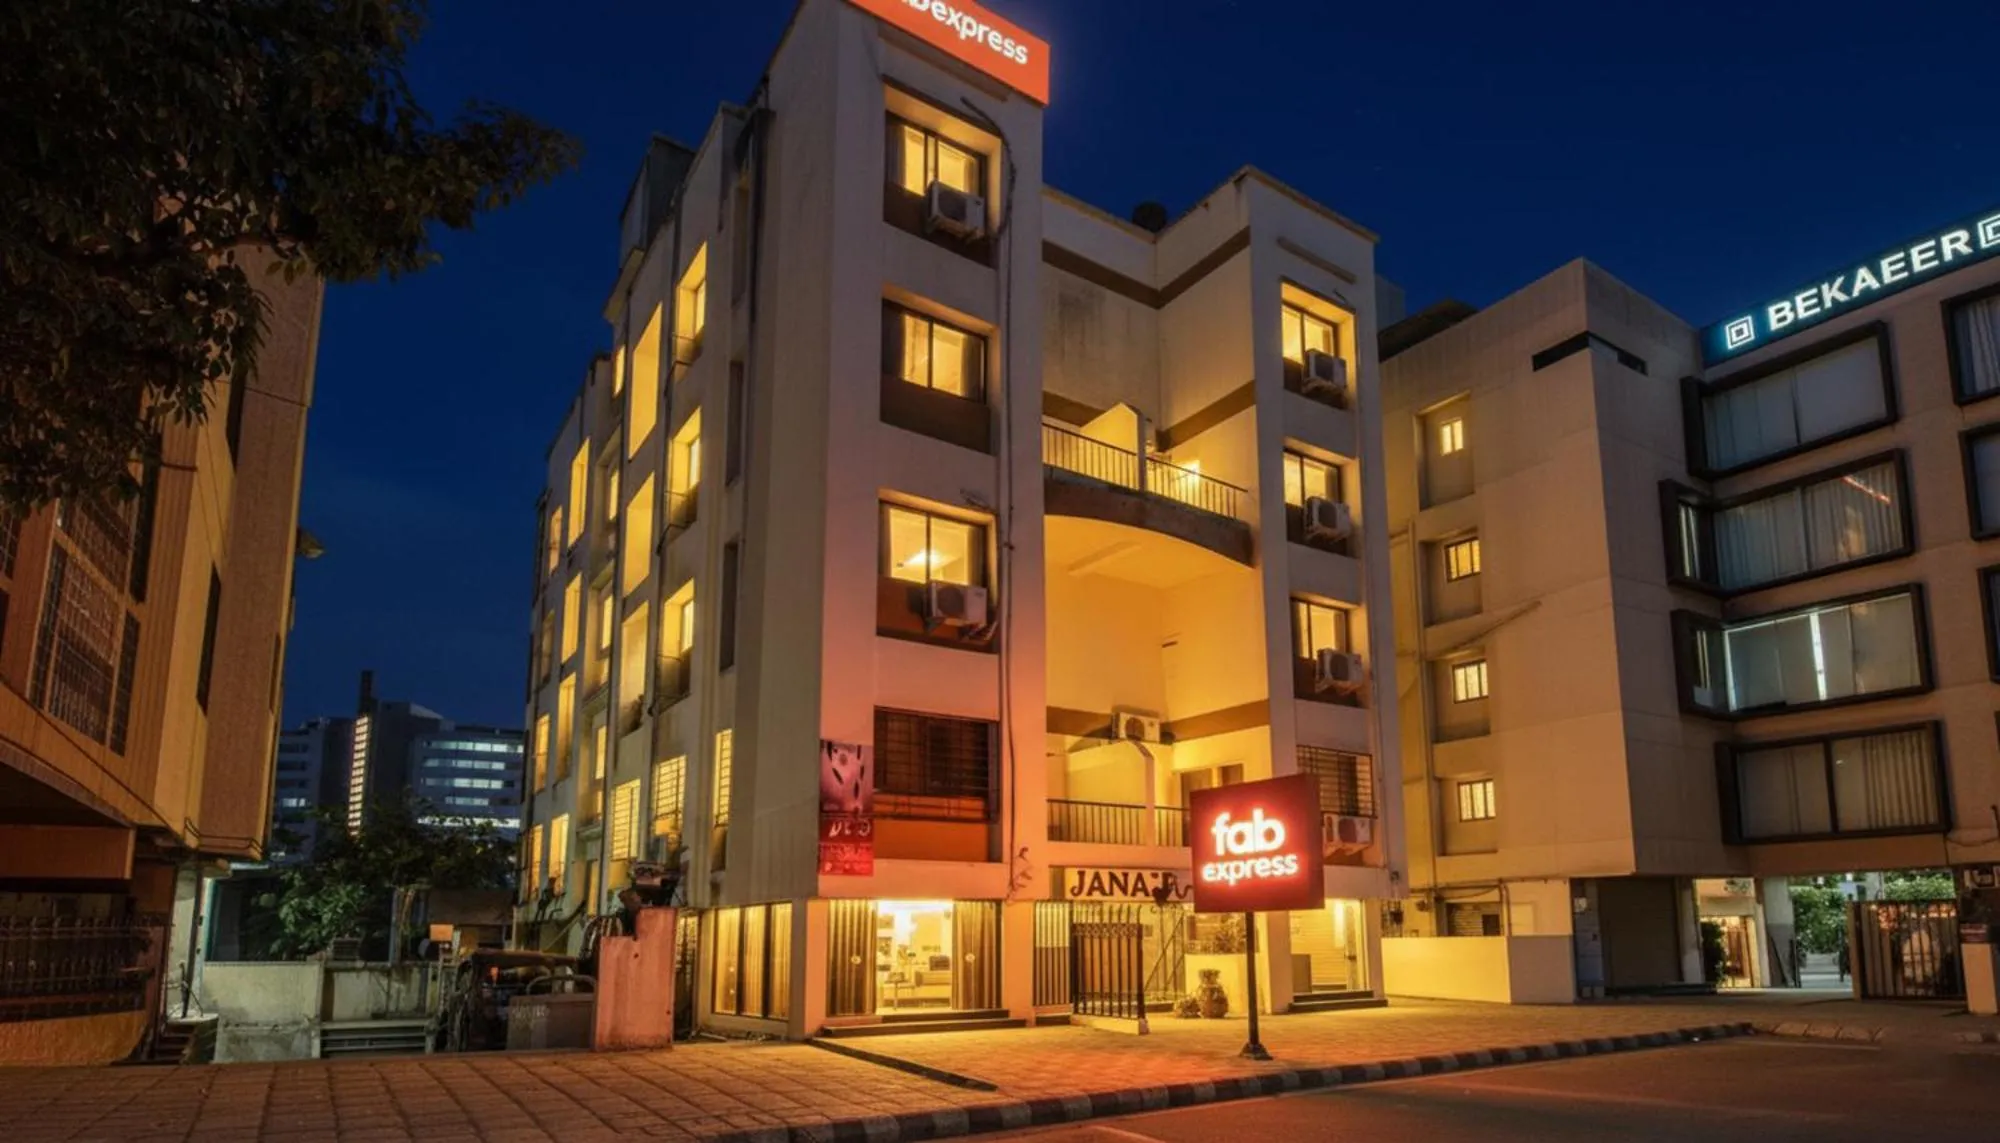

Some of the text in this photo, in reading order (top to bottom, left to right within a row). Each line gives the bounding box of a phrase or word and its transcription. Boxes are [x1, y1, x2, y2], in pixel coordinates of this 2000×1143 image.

[1767, 229, 1973, 330] BEKAEER
[1211, 808, 1286, 856] fab
[1202, 853, 1299, 886] express
